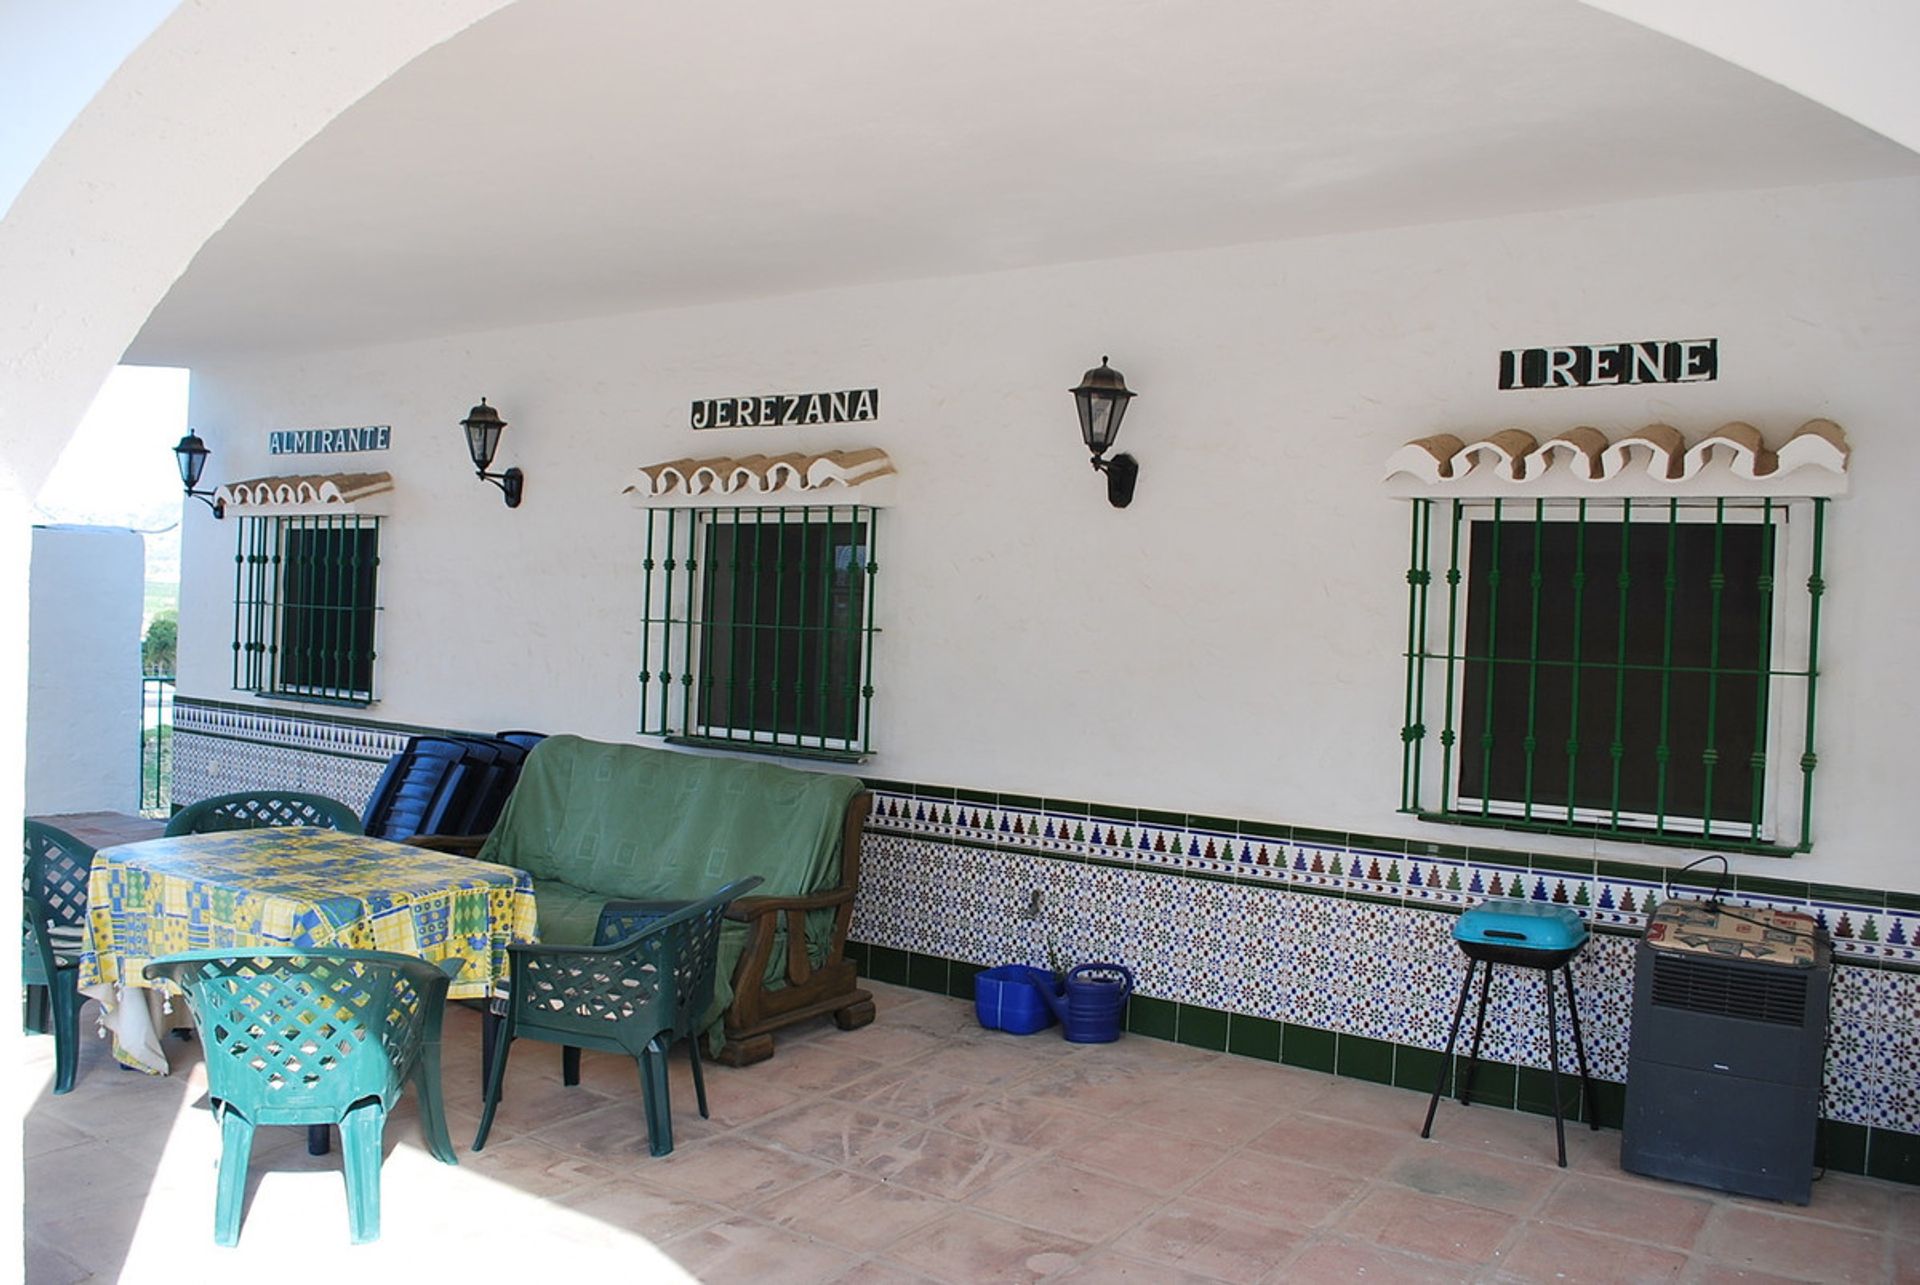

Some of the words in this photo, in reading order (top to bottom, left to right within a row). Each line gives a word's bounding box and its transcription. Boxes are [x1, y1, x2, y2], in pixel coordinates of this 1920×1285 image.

[1509, 340, 1711, 388] IRENE
[693, 390, 876, 428] JEREZANA
[270, 426, 389, 454] ALMIRANTE
